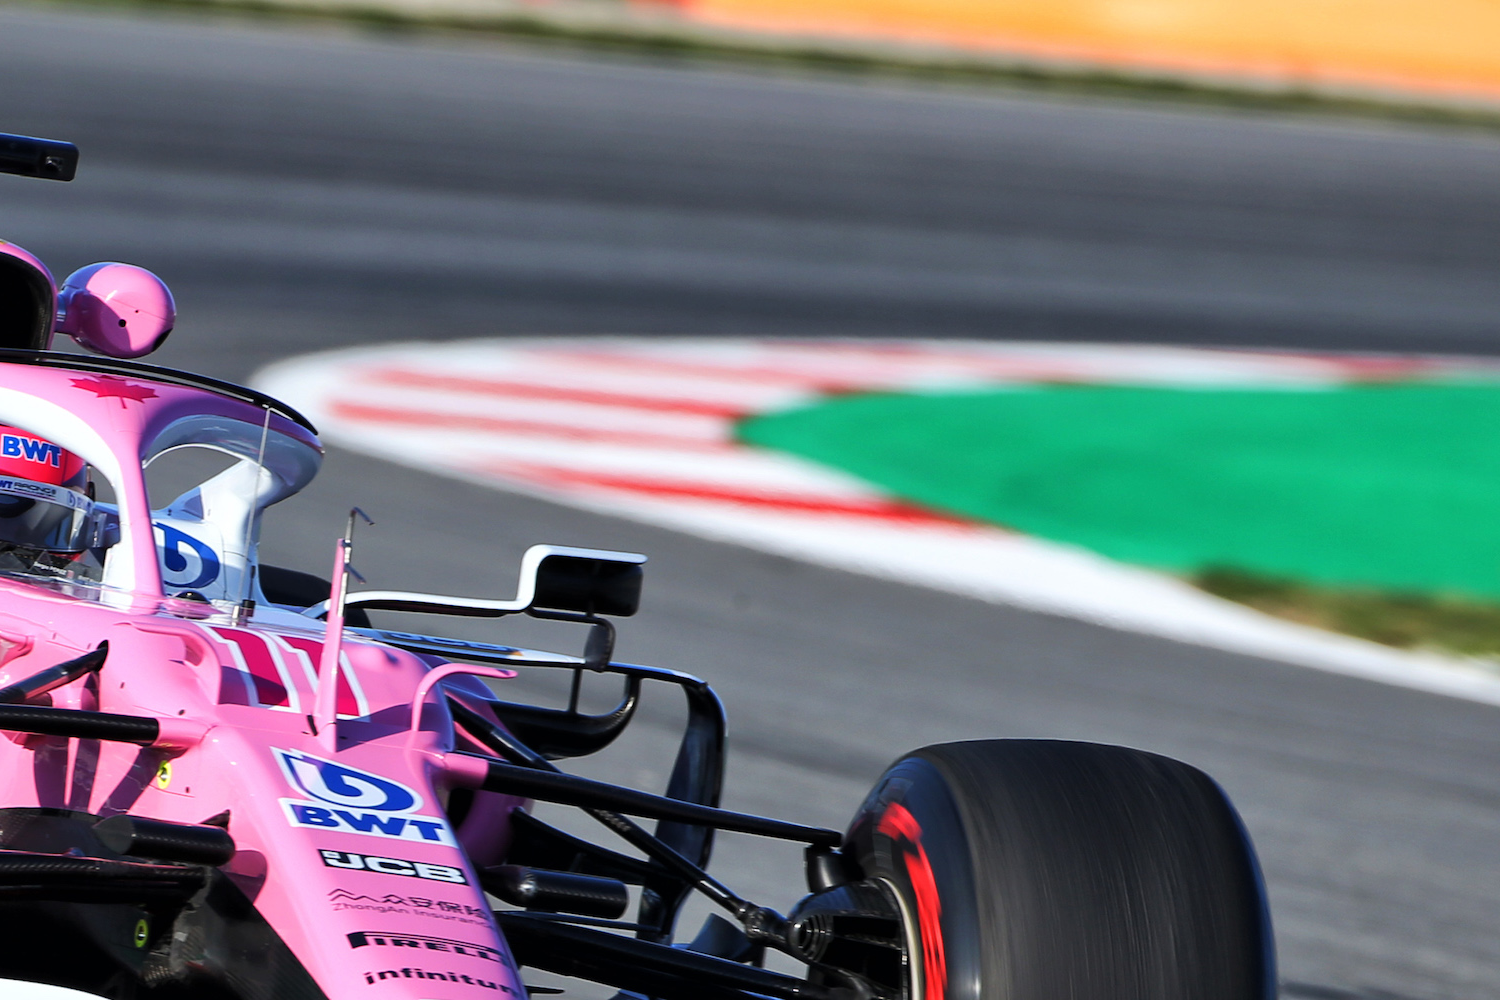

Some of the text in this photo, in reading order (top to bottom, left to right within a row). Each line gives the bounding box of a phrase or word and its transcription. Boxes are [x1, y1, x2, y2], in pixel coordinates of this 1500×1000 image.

[3, 435, 61, 467] BWT
[290, 803, 445, 842] BWT
[321, 850, 466, 884] JCB
[333, 902, 409, 915] ZhongAn
